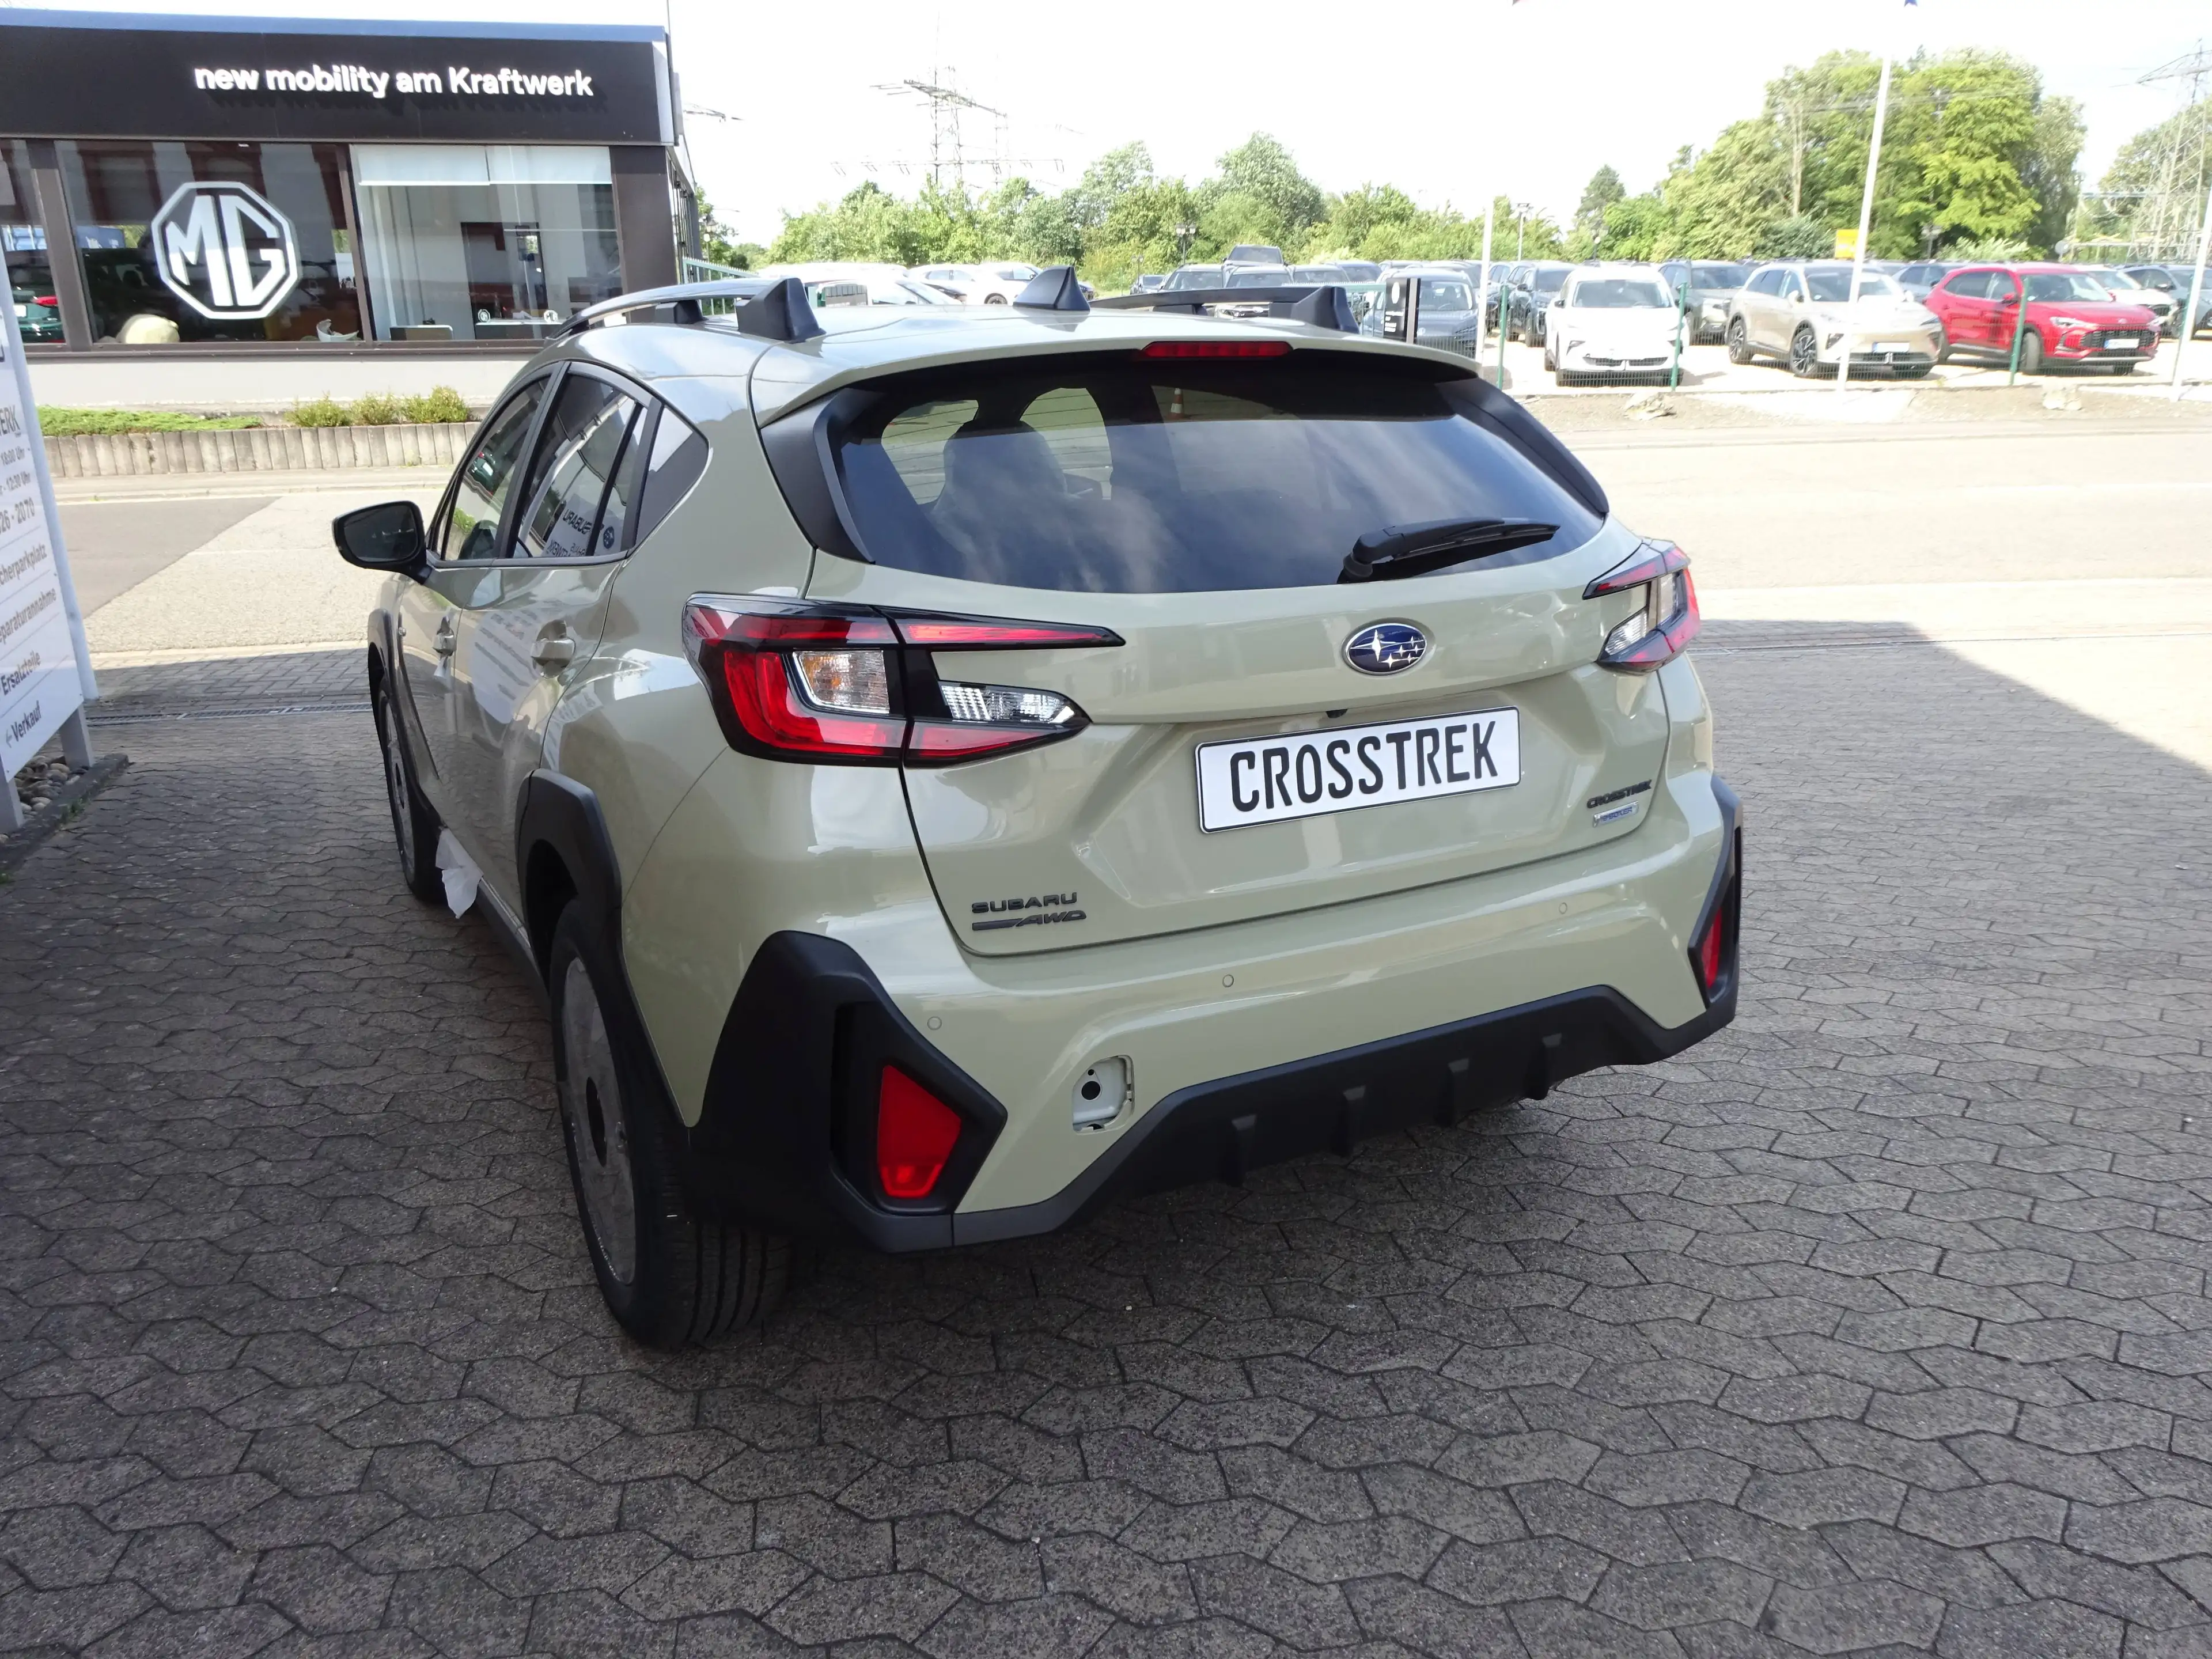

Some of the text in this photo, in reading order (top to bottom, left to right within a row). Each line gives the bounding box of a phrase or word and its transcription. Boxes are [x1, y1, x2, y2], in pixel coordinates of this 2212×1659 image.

[195, 64, 594, 99] new mobility am Kraftwerk
[165, 195, 286, 306] MG
[0, 405, 20, 436] ERK
[14, 497, 35, 524] 2070
[0, 544, 47, 586] cherparkplatz
[1, 650, 41, 696] Ersatzteile
[11, 700, 41, 742] Verkauf
[1230, 721, 1498, 812] CROSSTREK
[972, 892, 1077, 914] SUBARU
[1016, 910, 1087, 927] AWD
